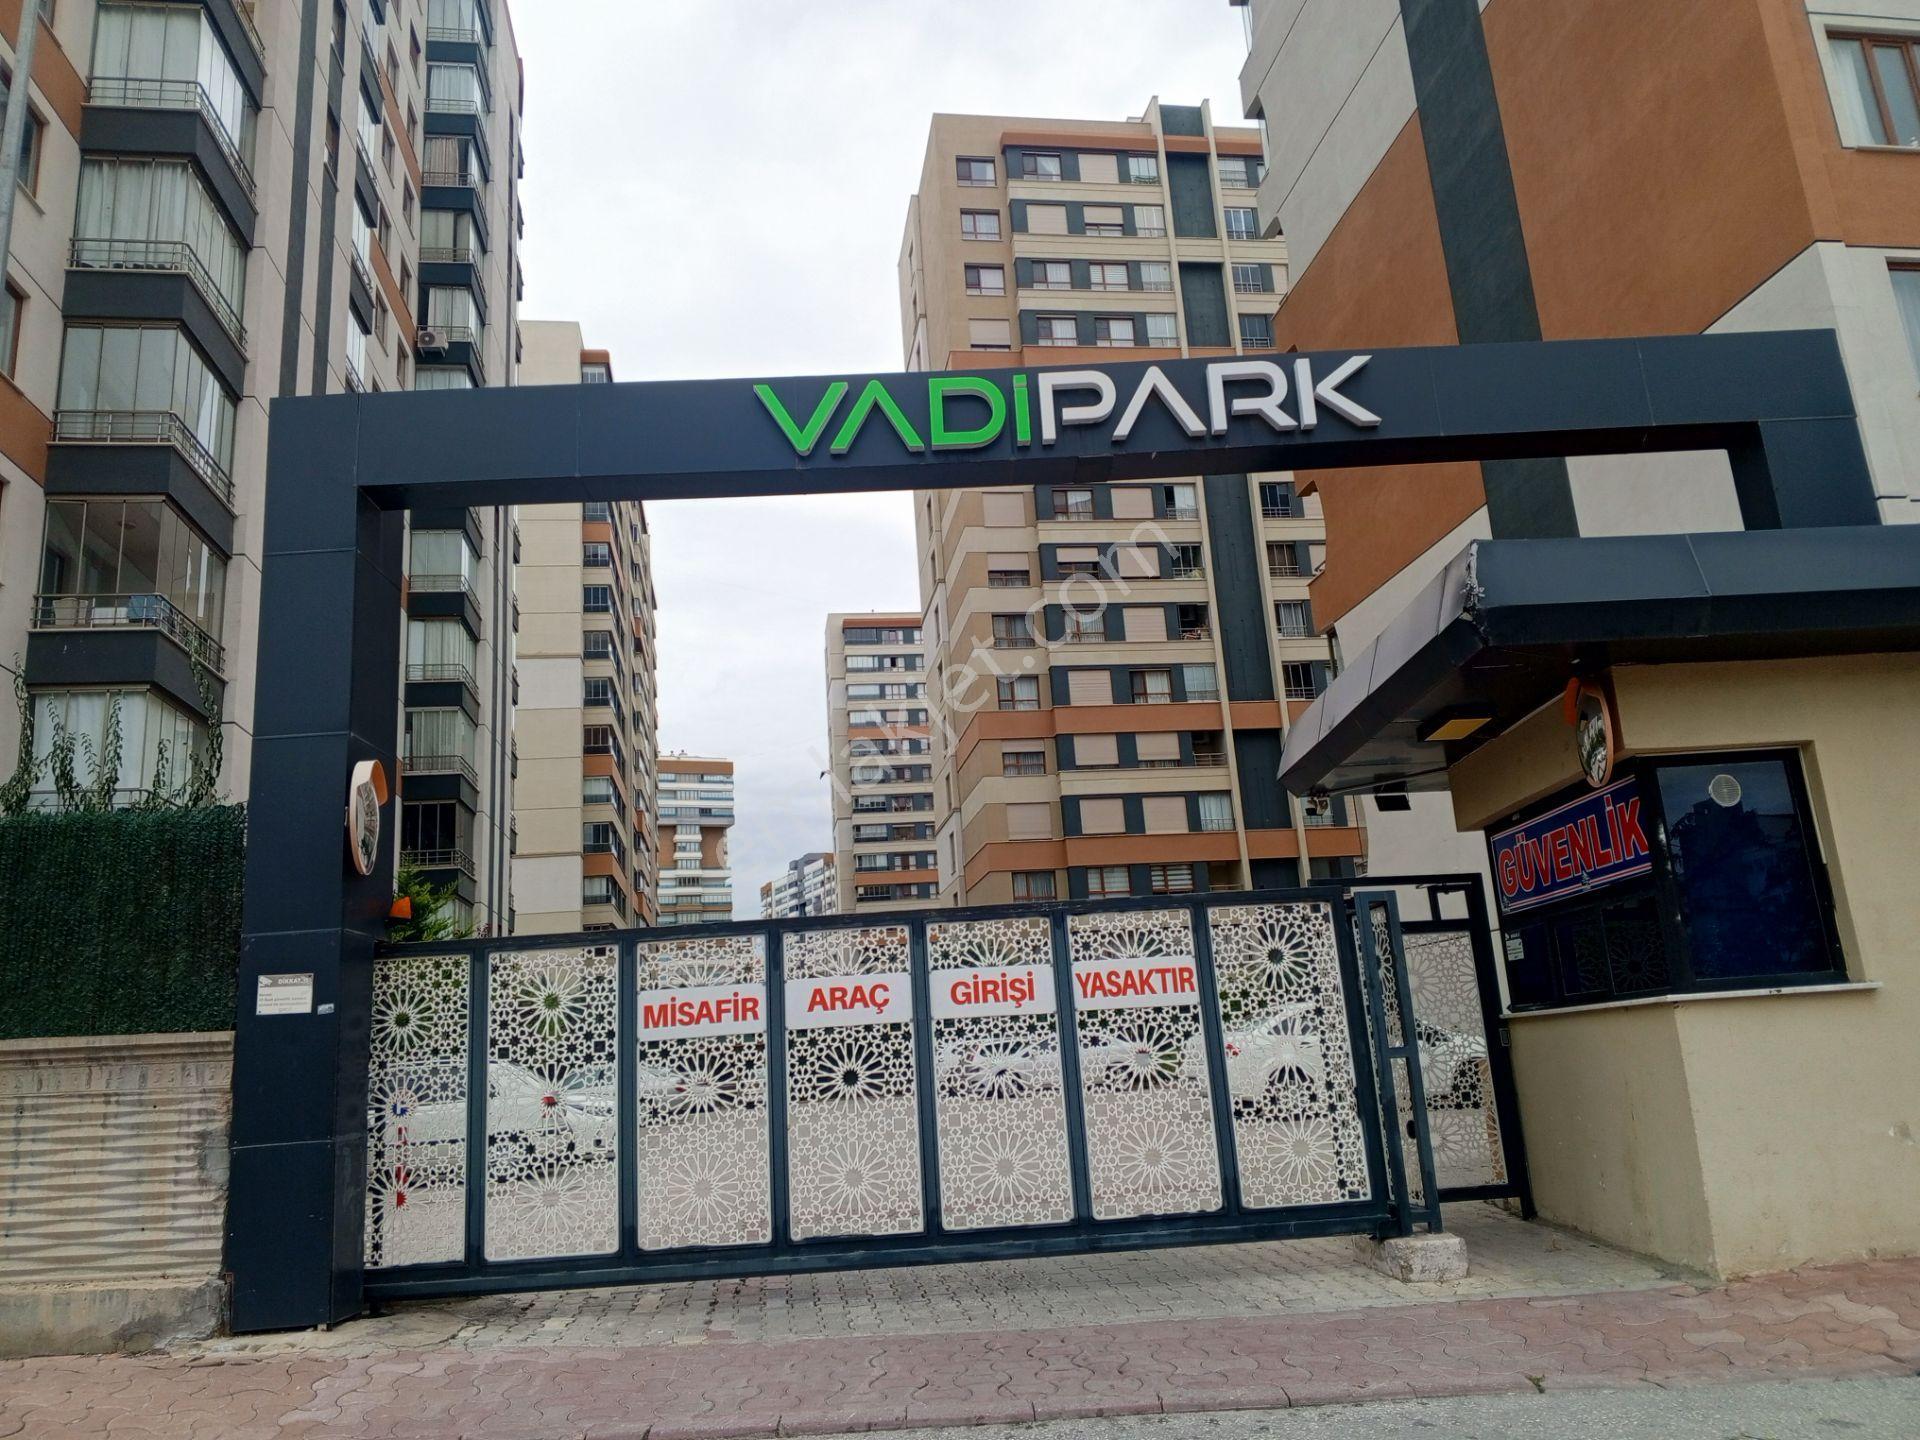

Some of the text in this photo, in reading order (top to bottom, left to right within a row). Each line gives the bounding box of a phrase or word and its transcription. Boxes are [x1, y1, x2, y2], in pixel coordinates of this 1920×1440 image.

[1498, 794, 1649, 897] GÜVENLİK
[643, 966, 1196, 1029] MİSAFİR ARAÇ GİRİŞİ YASAKTIR
